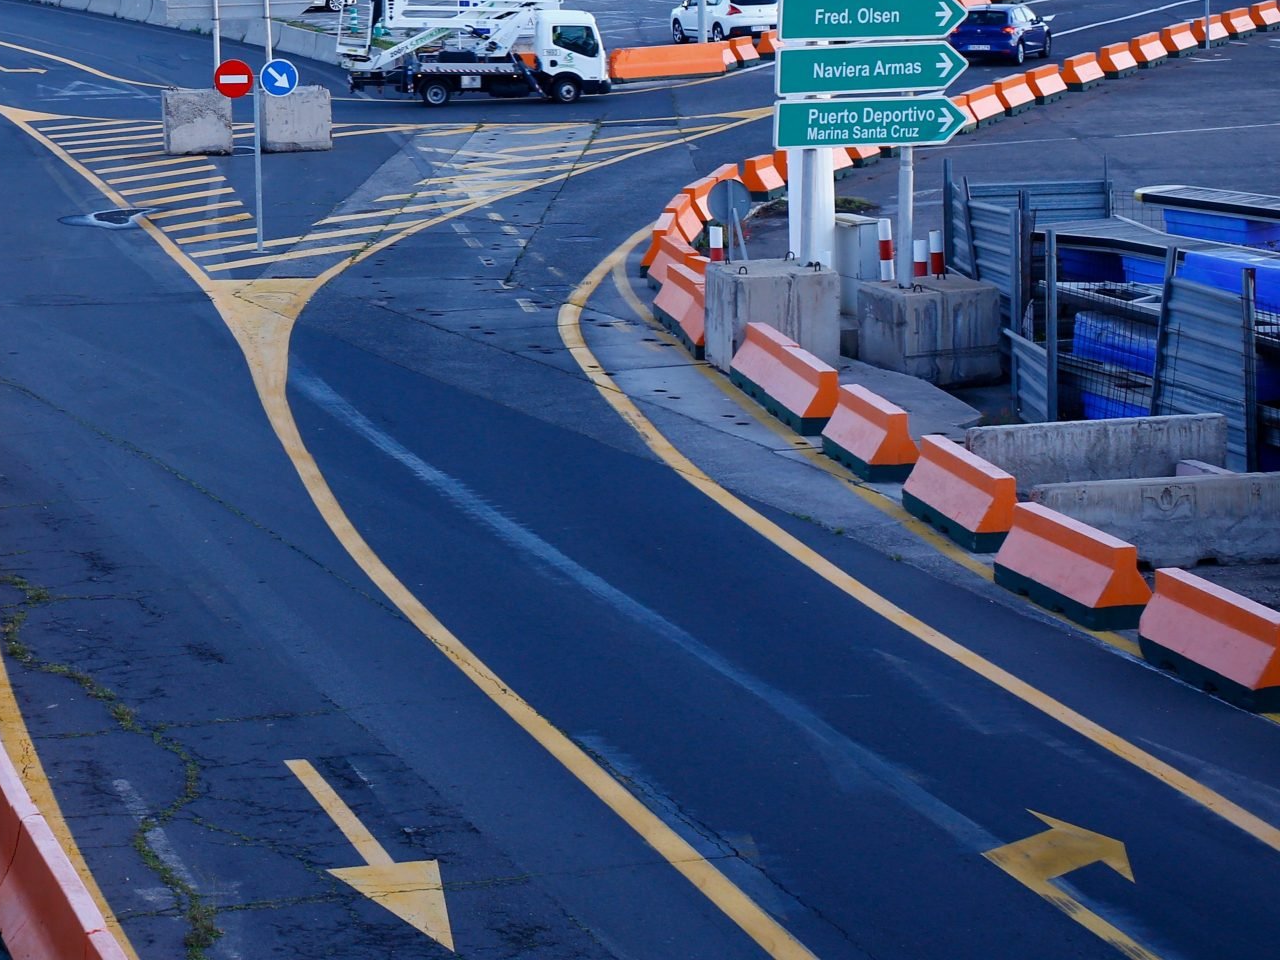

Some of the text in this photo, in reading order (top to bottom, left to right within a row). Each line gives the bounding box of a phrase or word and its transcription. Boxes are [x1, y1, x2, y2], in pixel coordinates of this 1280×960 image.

[815, 7, 900, 25] Fred. Olsen
[813, 60, 922, 79] Naviera Armas
[808, 106, 935, 126] Puerto Deportivo
[807, 125, 919, 140] Marina Santa Cruz
